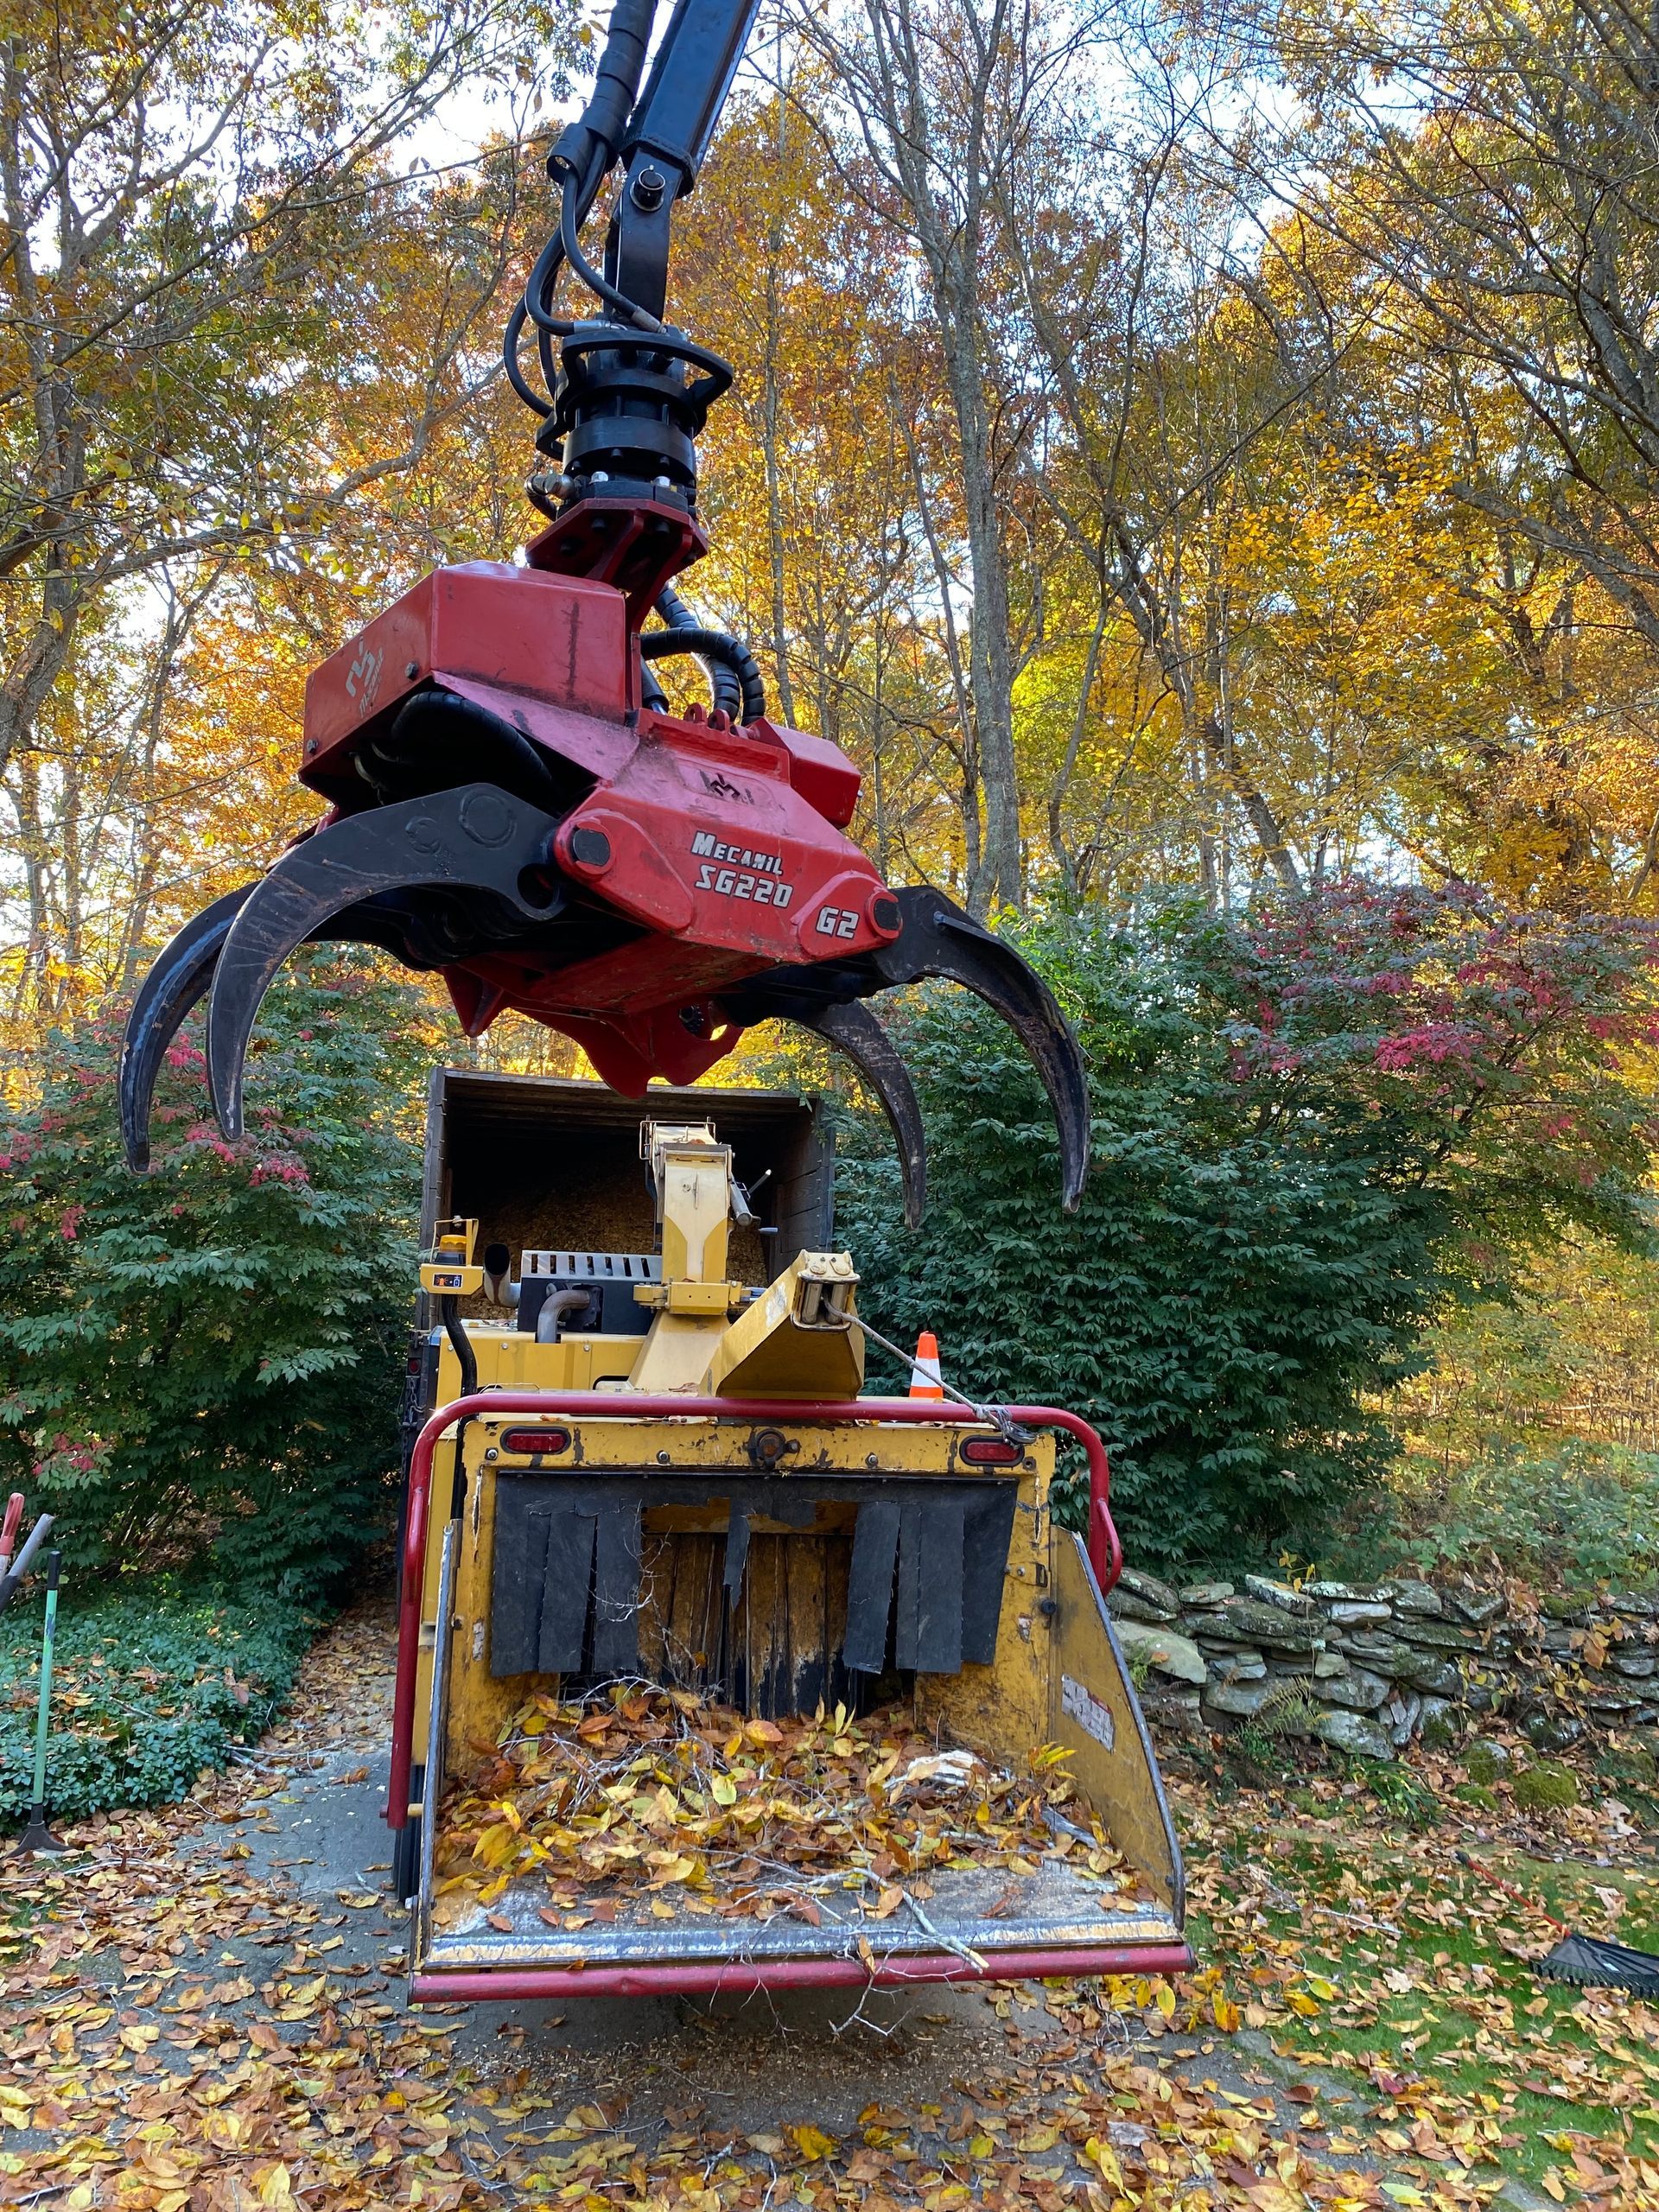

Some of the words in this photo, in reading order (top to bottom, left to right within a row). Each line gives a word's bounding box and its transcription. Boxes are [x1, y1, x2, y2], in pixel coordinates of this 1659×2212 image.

[692, 831, 783, 874] MECANIL
[695, 865, 793, 908] SG220
[816, 906, 860, 938] G2
